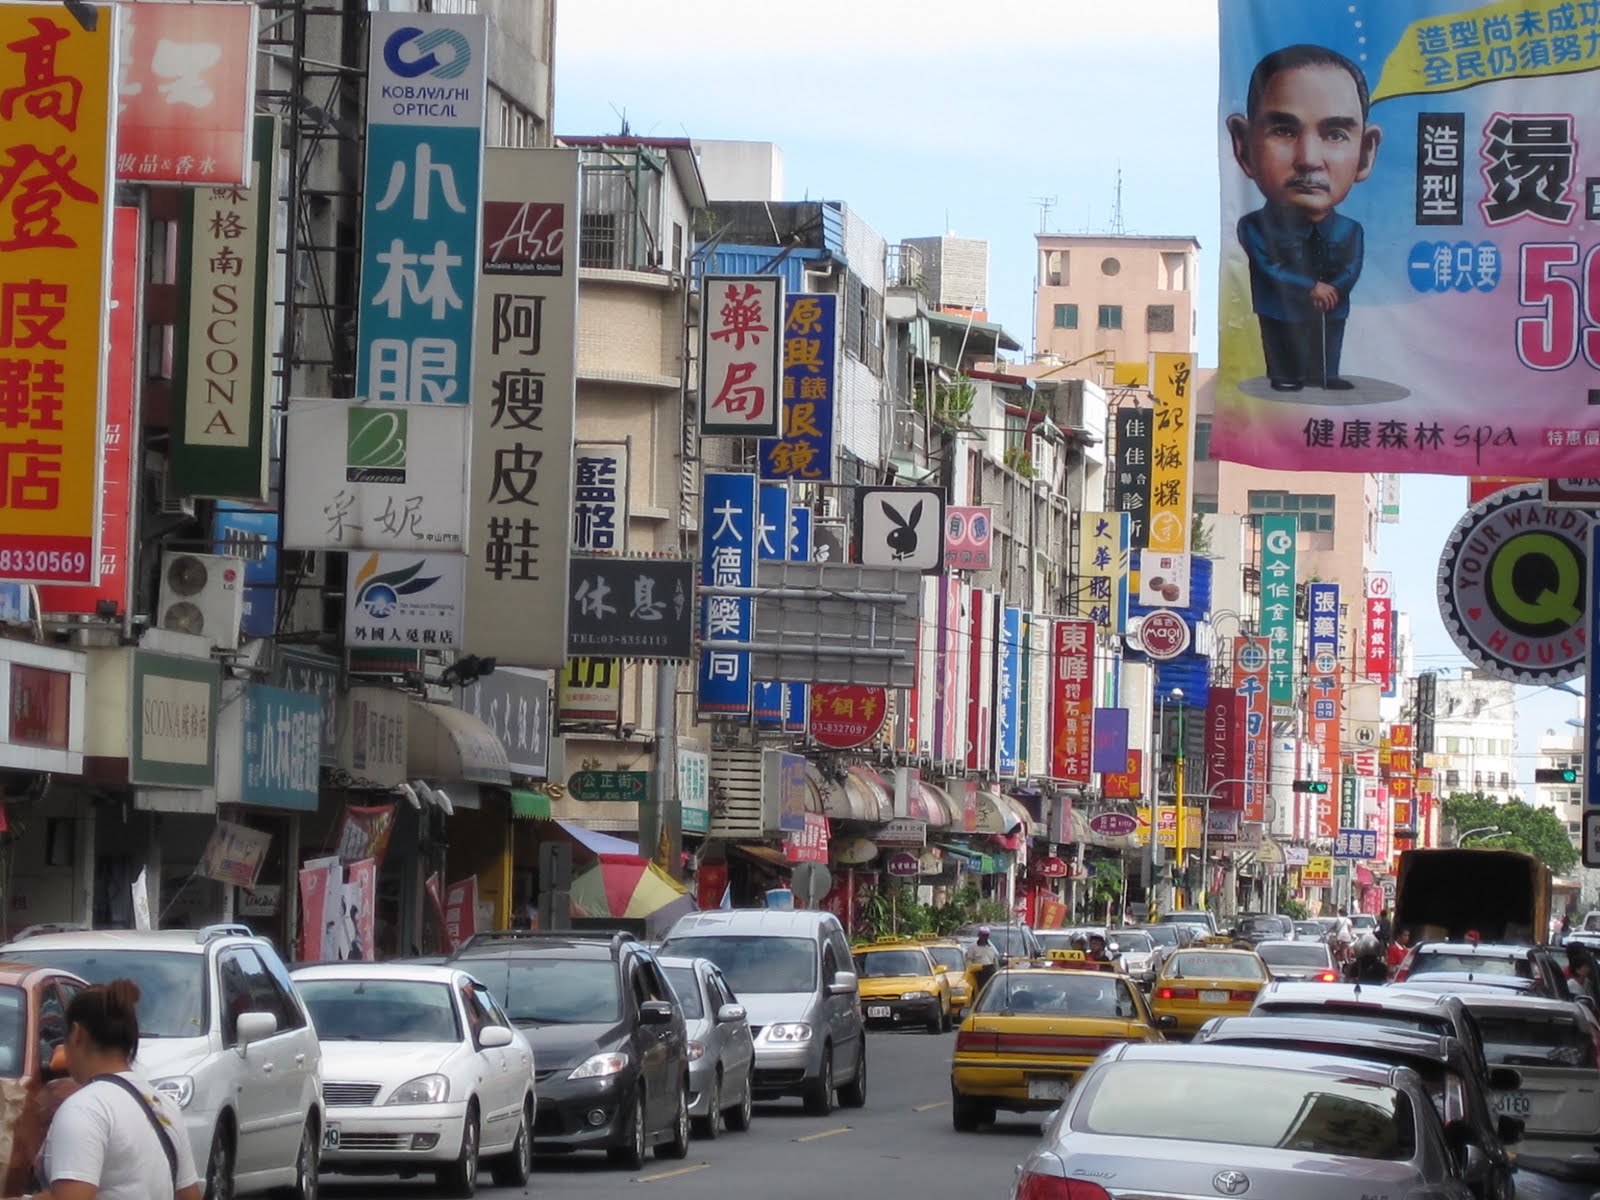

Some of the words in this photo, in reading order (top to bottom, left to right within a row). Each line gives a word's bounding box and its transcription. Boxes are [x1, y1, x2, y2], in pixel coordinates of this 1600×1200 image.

[382, 86, 469, 100] KOBAYASHI
[393, 103, 457, 117] OPTICAL
[1423, 125, 1458, 216] 造型
[1484, 115, 1576, 225] 燙
[0, 17, 98, 510] 高登皮鞋店
[1411, 245, 1497, 288] 一律只要
[711, 283, 769, 420] 藥局
[485, 294, 546, 580] 阿瘦皮鞋
[1303, 418, 1446, 450] 健康森林
[1453, 424, 1518, 464] spa
[574, 457, 616, 549] 藍格
[0, 551, 85, 573] 8330569
[1460, 525, 1501, 590] YOUR
[708, 500, 743, 681] 大德藥局
[355, 626, 453, 644] 外國人免稅店
[1371, 600, 1387, 659] 華南銀行
[811, 722, 868, 735] 03-8327097
[1336, 833, 1377, 856] 張藥局
[1052, 951, 1081, 960] TAXI
